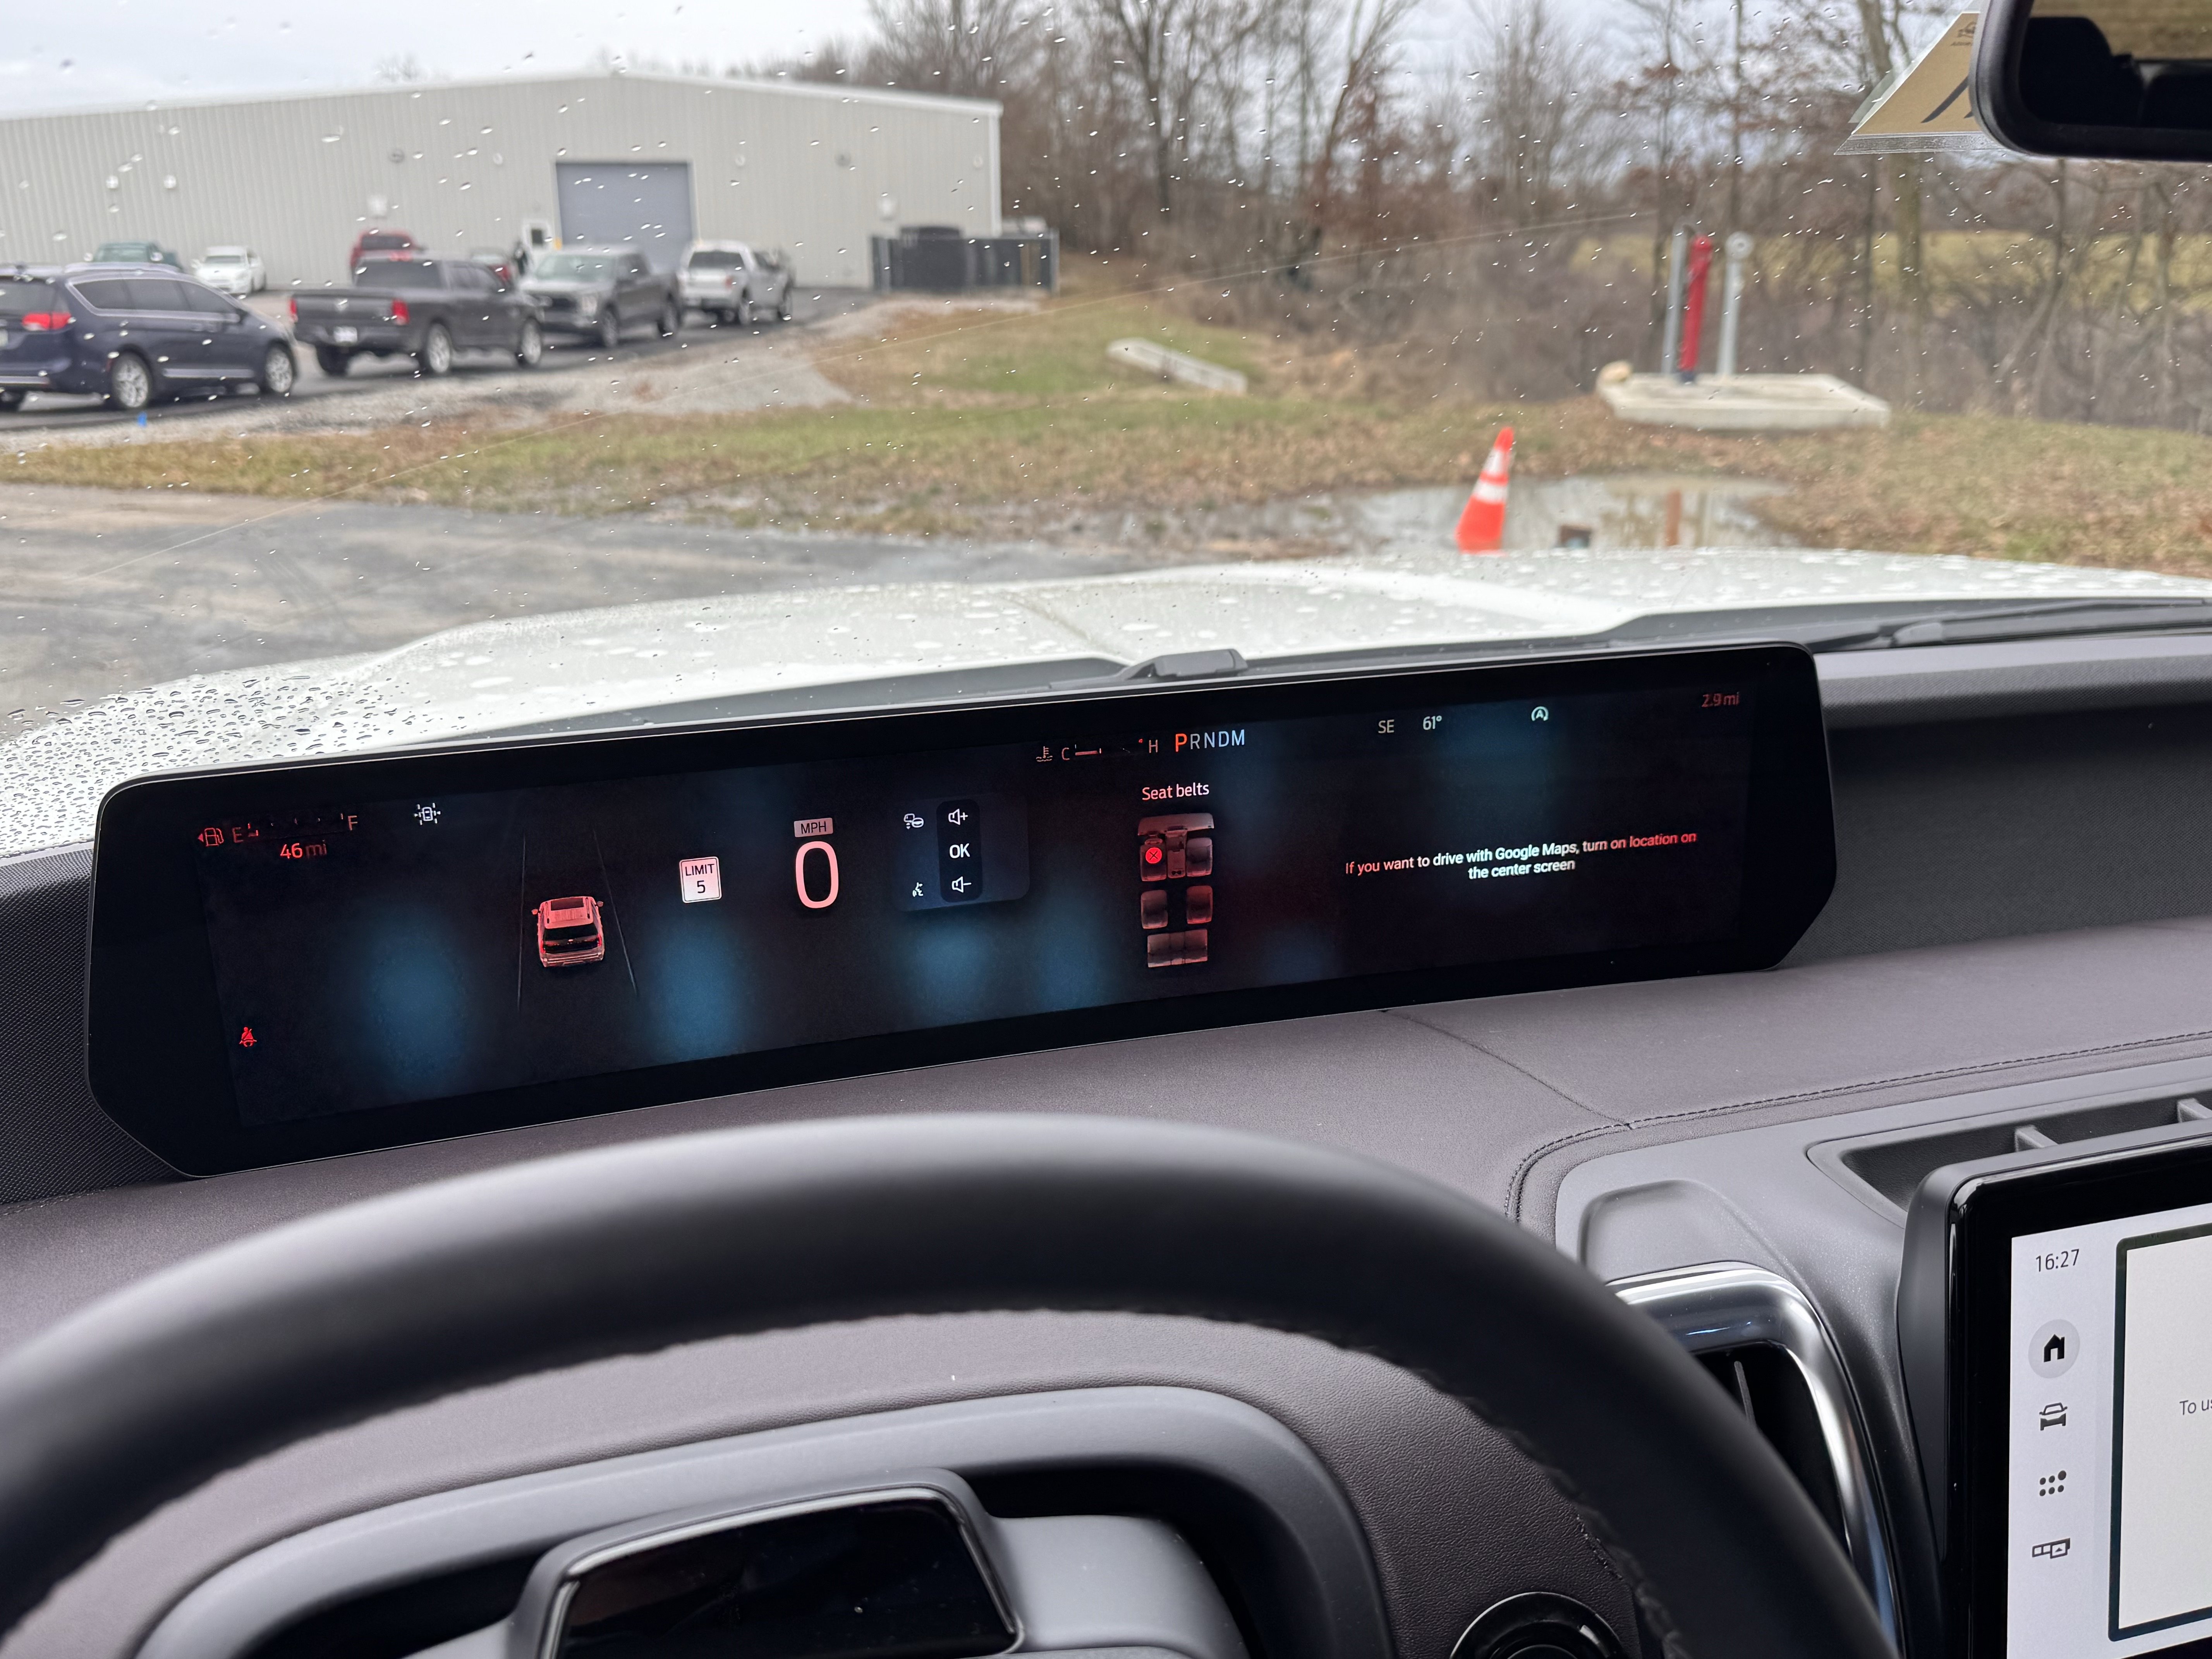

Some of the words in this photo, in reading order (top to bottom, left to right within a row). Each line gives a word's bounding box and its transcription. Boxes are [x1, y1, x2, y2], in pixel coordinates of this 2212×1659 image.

[1723, 692, 1740, 705] mi
[1378, 720, 1395, 733] SE
[1061, 747, 1070, 761] C
[1149, 739, 1158, 754] H
[1142, 785, 1173, 800] Seat
[1176, 782, 1210, 798] belts
[348, 815, 357, 831] F
[800, 821, 827, 835] MPH
[233, 827, 243, 843] E
[280, 843, 303, 859] 46
[305, 839, 327, 859] mi
[949, 843, 970, 859] OK
[1346, 861, 1355, 874] If
[1358, 862, 1380, 876] you
[1384, 857, 1414, 871] want
[1417, 856, 1431, 868] to
[1433, 852, 1463, 866] drive
[1466, 848, 1493, 863] with
[1495, 844, 1539, 861] Google
[1542, 842, 1580, 857] Maps,
[1582, 841, 1607, 852] turn
[1610, 839, 1626, 850] on
[1630, 833, 1678, 848] location
[1681, 833, 1697, 843] on
[685, 864, 715, 876] LIMIT
[795, 841, 839, 909] 0
[1468, 866, 1489, 879] the
[1491, 862, 1531, 876] center
[1534, 860, 1576, 874] screen
[697, 880, 706, 894] 5
[2036, 1248, 2080, 1273] 16:27
[2179, 1400, 2197, 1415] To
